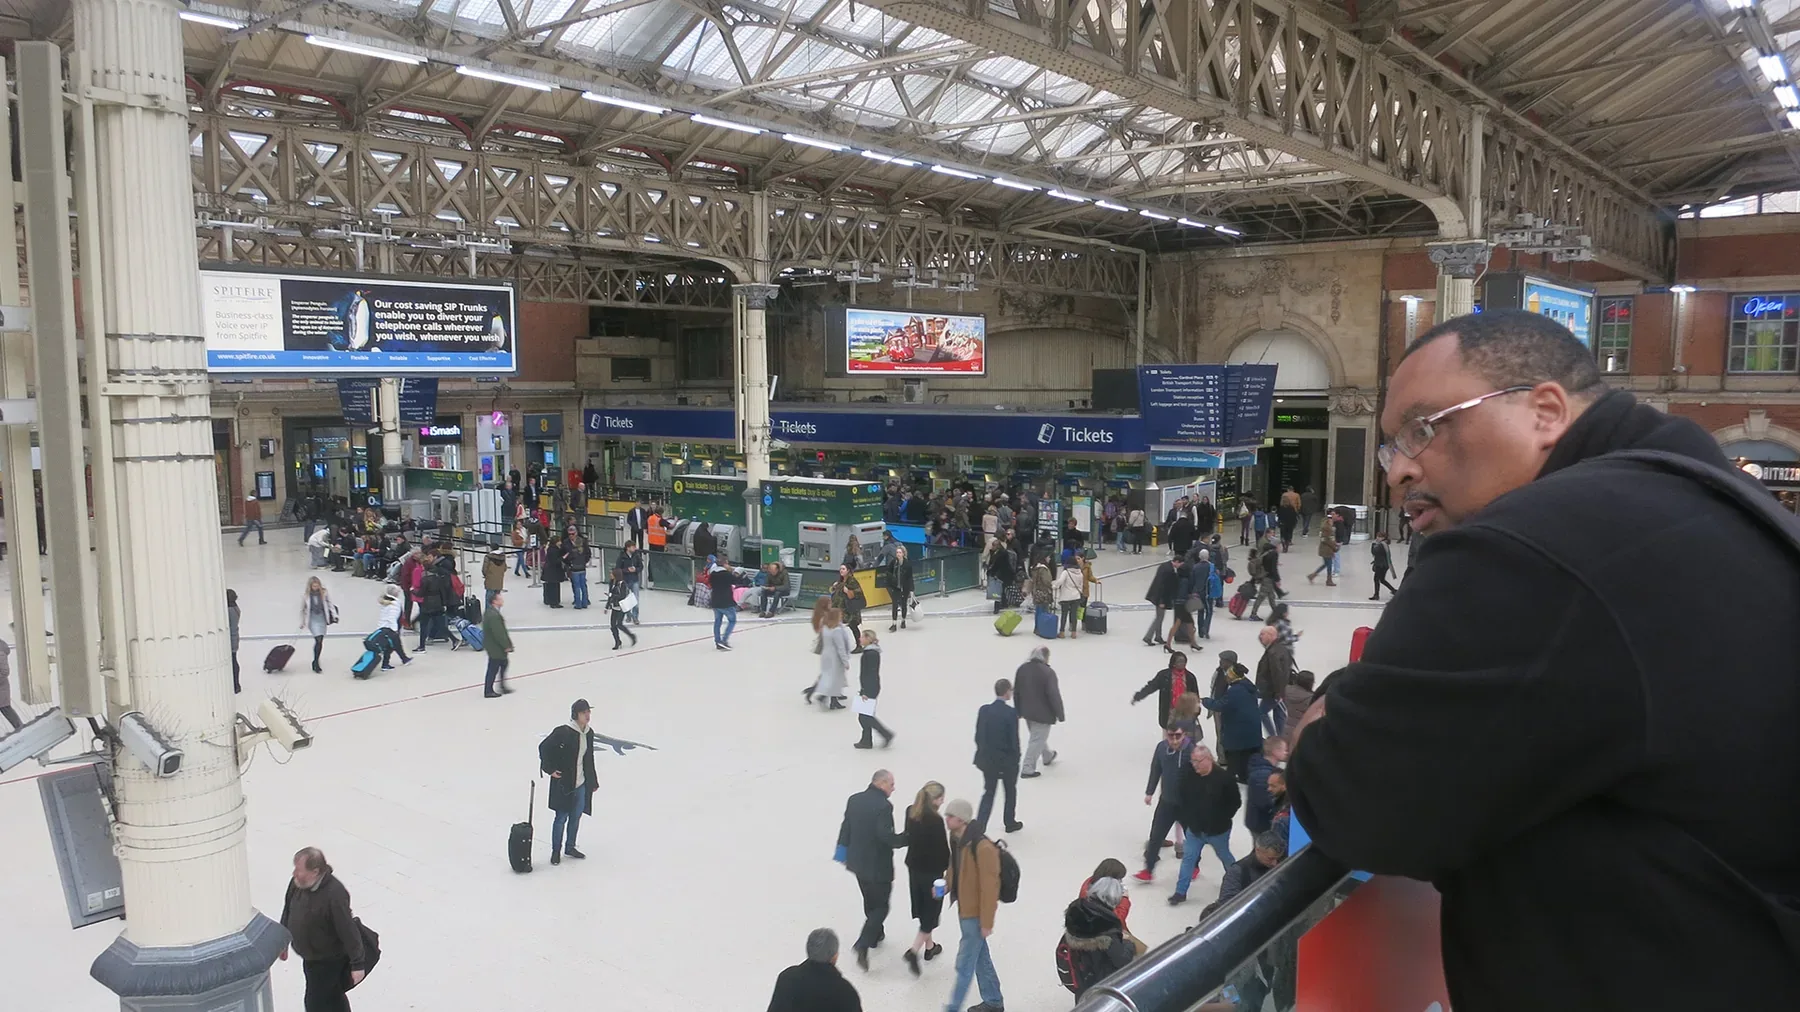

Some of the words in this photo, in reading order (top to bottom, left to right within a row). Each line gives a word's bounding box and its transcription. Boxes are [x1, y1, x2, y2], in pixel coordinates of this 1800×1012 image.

[213, 286, 273, 298] SPITFIRE
[374, 300, 392, 308] Our
[393, 301, 413, 310] cost
[414, 301, 442, 313] saving
[444, 302, 457, 310] SIP
[458, 303, 488, 312] Trunks
[1744, 297, 1784, 317] Open
[215, 311, 273, 320] Business-class
[374, 311, 406, 319] enable
[407, 313, 425, 322] you
[426, 312, 435, 320] to
[436, 312, 463, 321] divert
[464, 314, 483, 323] your
[215, 321, 238, 329] Voice
[375, 321, 421, 331] telephone
[422, 322, 442, 331] calls
[443, 323, 484, 331] wherever
[238, 332, 268, 341] Spitfire
[375, 332, 393, 342] you
[394, 332, 418, 341] wish,
[420, 333, 462, 341] whenever
[464, 334, 480, 343] you
[481, 334, 500, 342] wish
[217, 352, 276, 361] www.spitfire.co.uk
[604, 416, 634, 428] Tickets
[780, 420, 817, 434] Tickets
[430, 424, 460, 435] iSmash
[1062, 426, 1114, 443] Tickets
[695, 482, 708, 490] tickets
[721, 484, 734, 492] collect
[780, 486, 791, 494] Train
[791, 487, 807, 495] tickets
[807, 488, 816, 497] buy
[821, 489, 836, 497] collect
